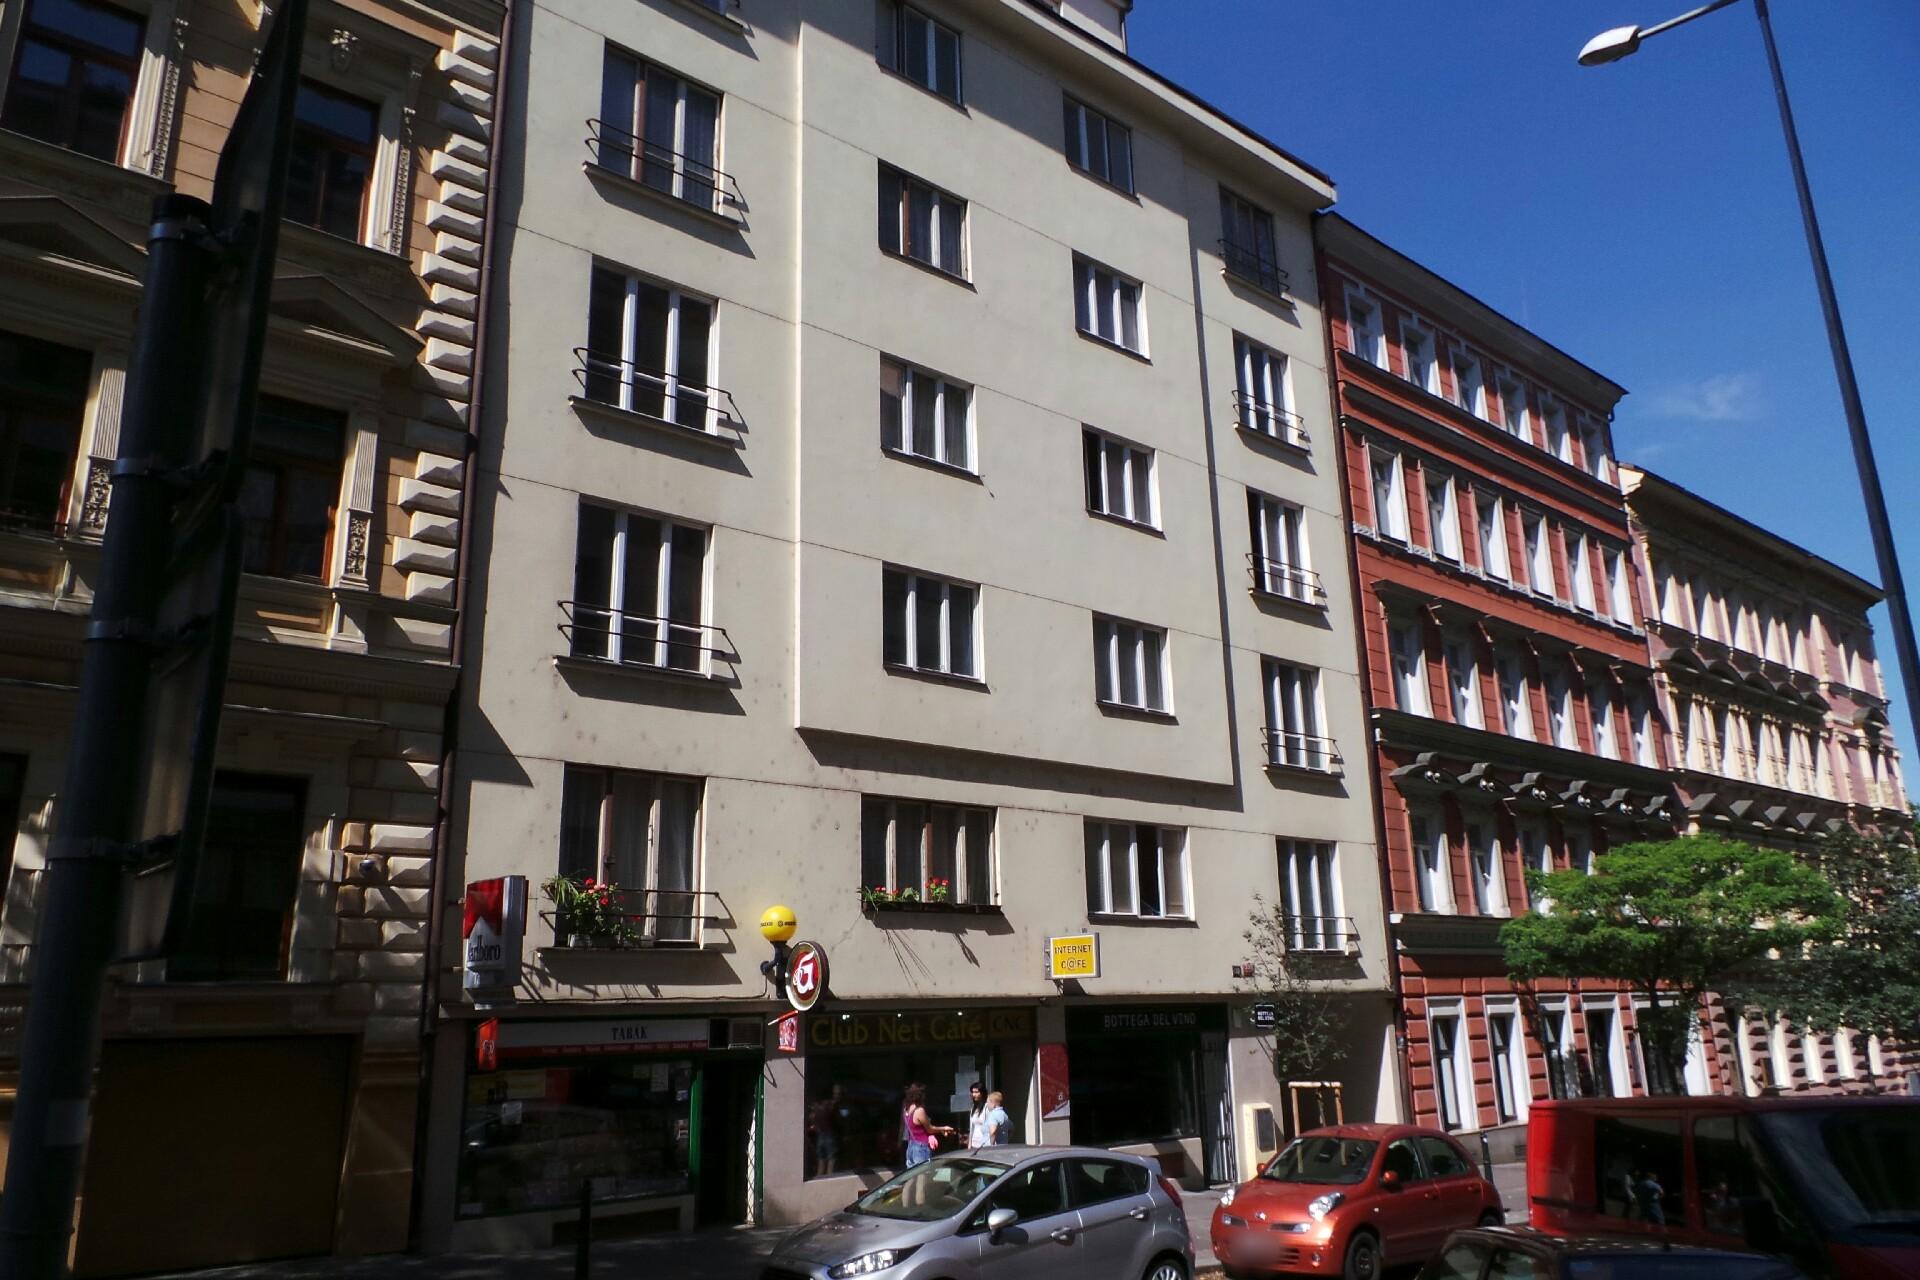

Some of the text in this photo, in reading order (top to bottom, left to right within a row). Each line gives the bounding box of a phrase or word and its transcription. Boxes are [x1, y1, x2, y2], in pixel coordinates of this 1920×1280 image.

[1054, 945, 1092, 954] INTERNET
[1104, 1012, 1151, 1028] BOTTEGA
[1152, 1013, 1171, 1026] DEL
[811, 1015, 870, 1046] Club
[879, 1014, 922, 1044] Net
